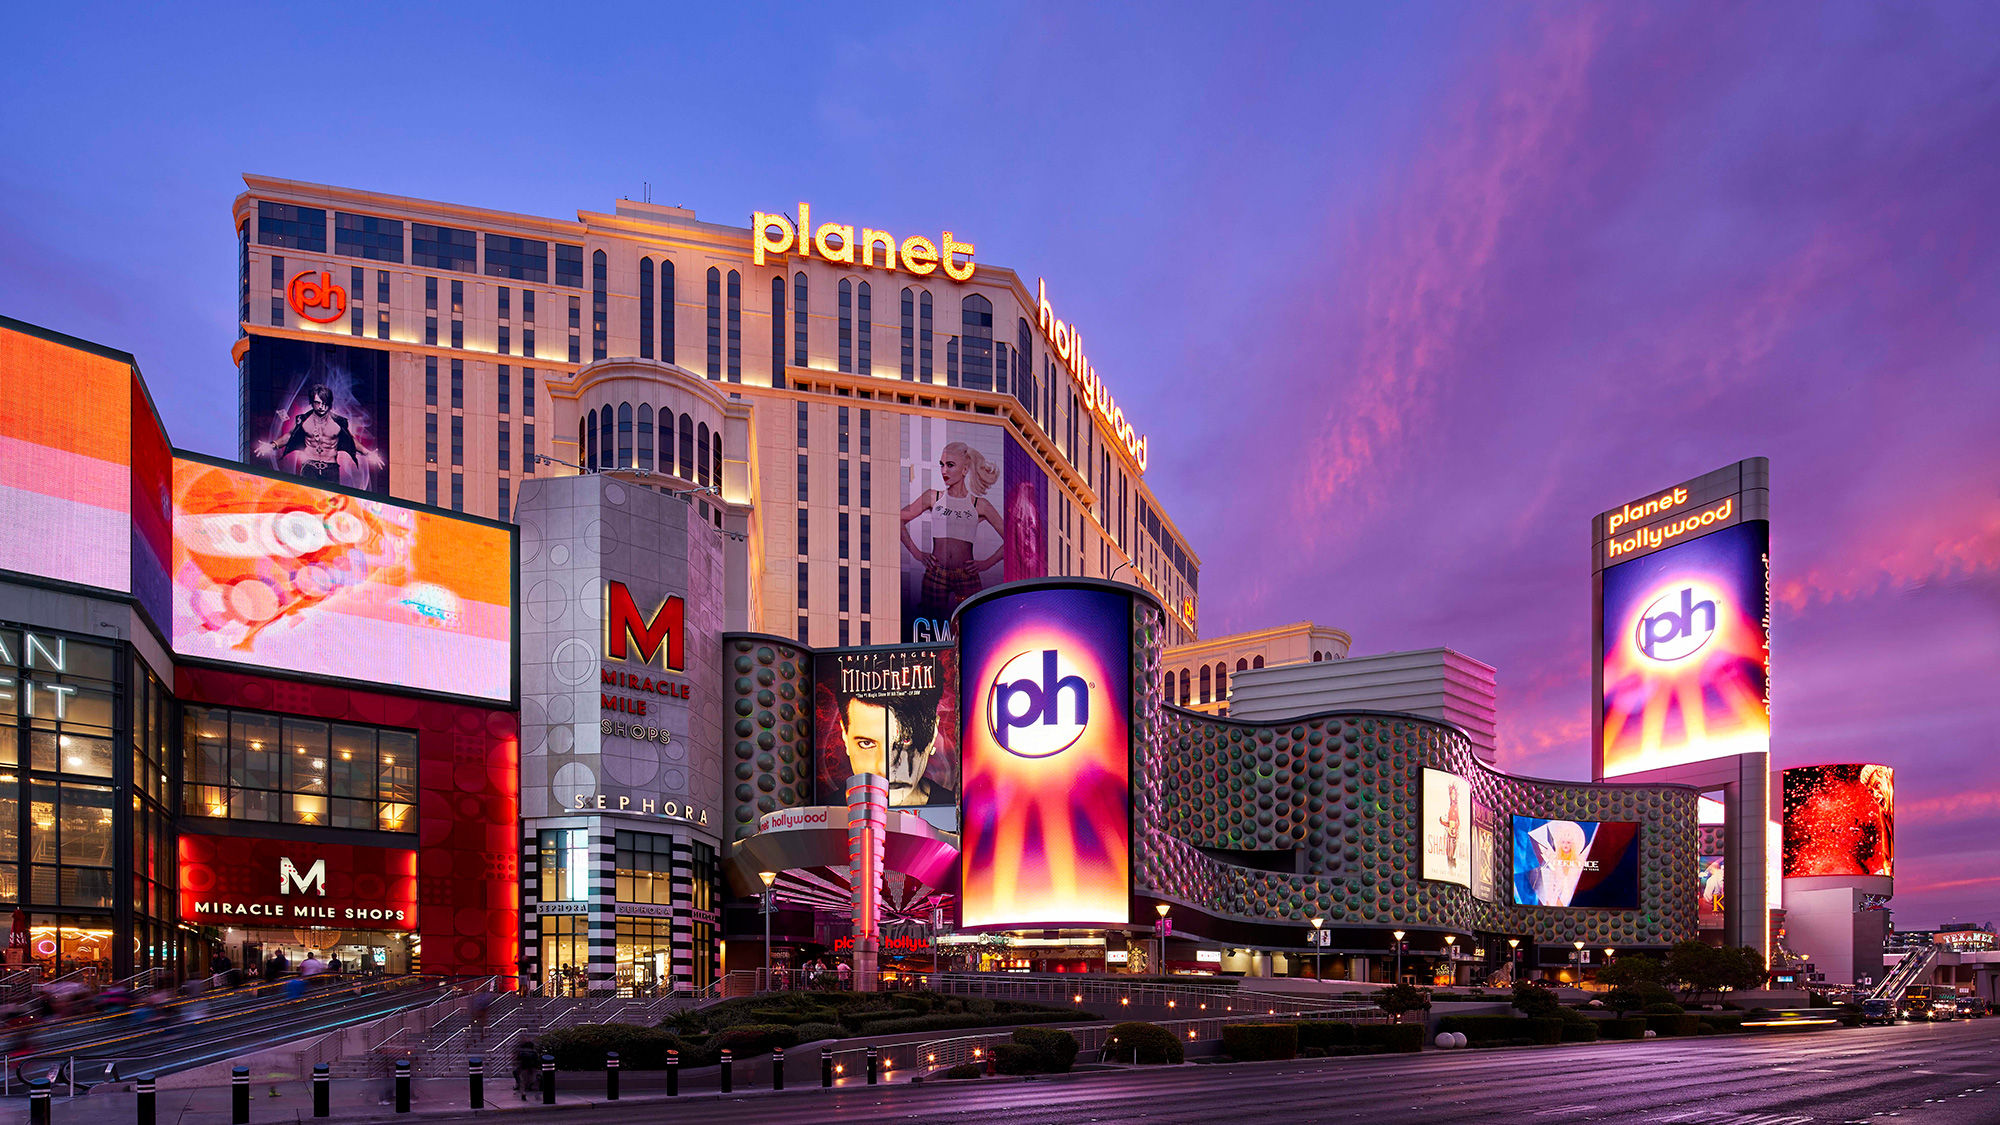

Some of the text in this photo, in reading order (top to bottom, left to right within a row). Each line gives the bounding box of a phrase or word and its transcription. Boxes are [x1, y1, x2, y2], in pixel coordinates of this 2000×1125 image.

[753, 202, 976, 282] planet
[294, 271, 347, 314] ph
[1038, 277, 1148, 472] hollywood
[1609, 487, 1689, 535] planet
[1609, 498, 1733, 558] hollywood
[608, 579, 685, 672] M
[1642, 587, 1717, 657] ph
[838, 651, 937, 662] CRISS ANGEL
[600, 668, 690, 700] MIRACLE
[996, 649, 1089, 749] ph
[600, 693, 647, 716] MILE
[600, 718, 671, 745] SHOPS
[574, 793, 708, 824] SEPHORA
[772, 811, 827, 828] hollywood
[280, 856, 326, 896] M
[194, 901, 405, 920] MIRACLE MILE SHOPS
[538, 904, 587, 913] SEPHORA
[618, 905, 671, 915] SEPHORA
